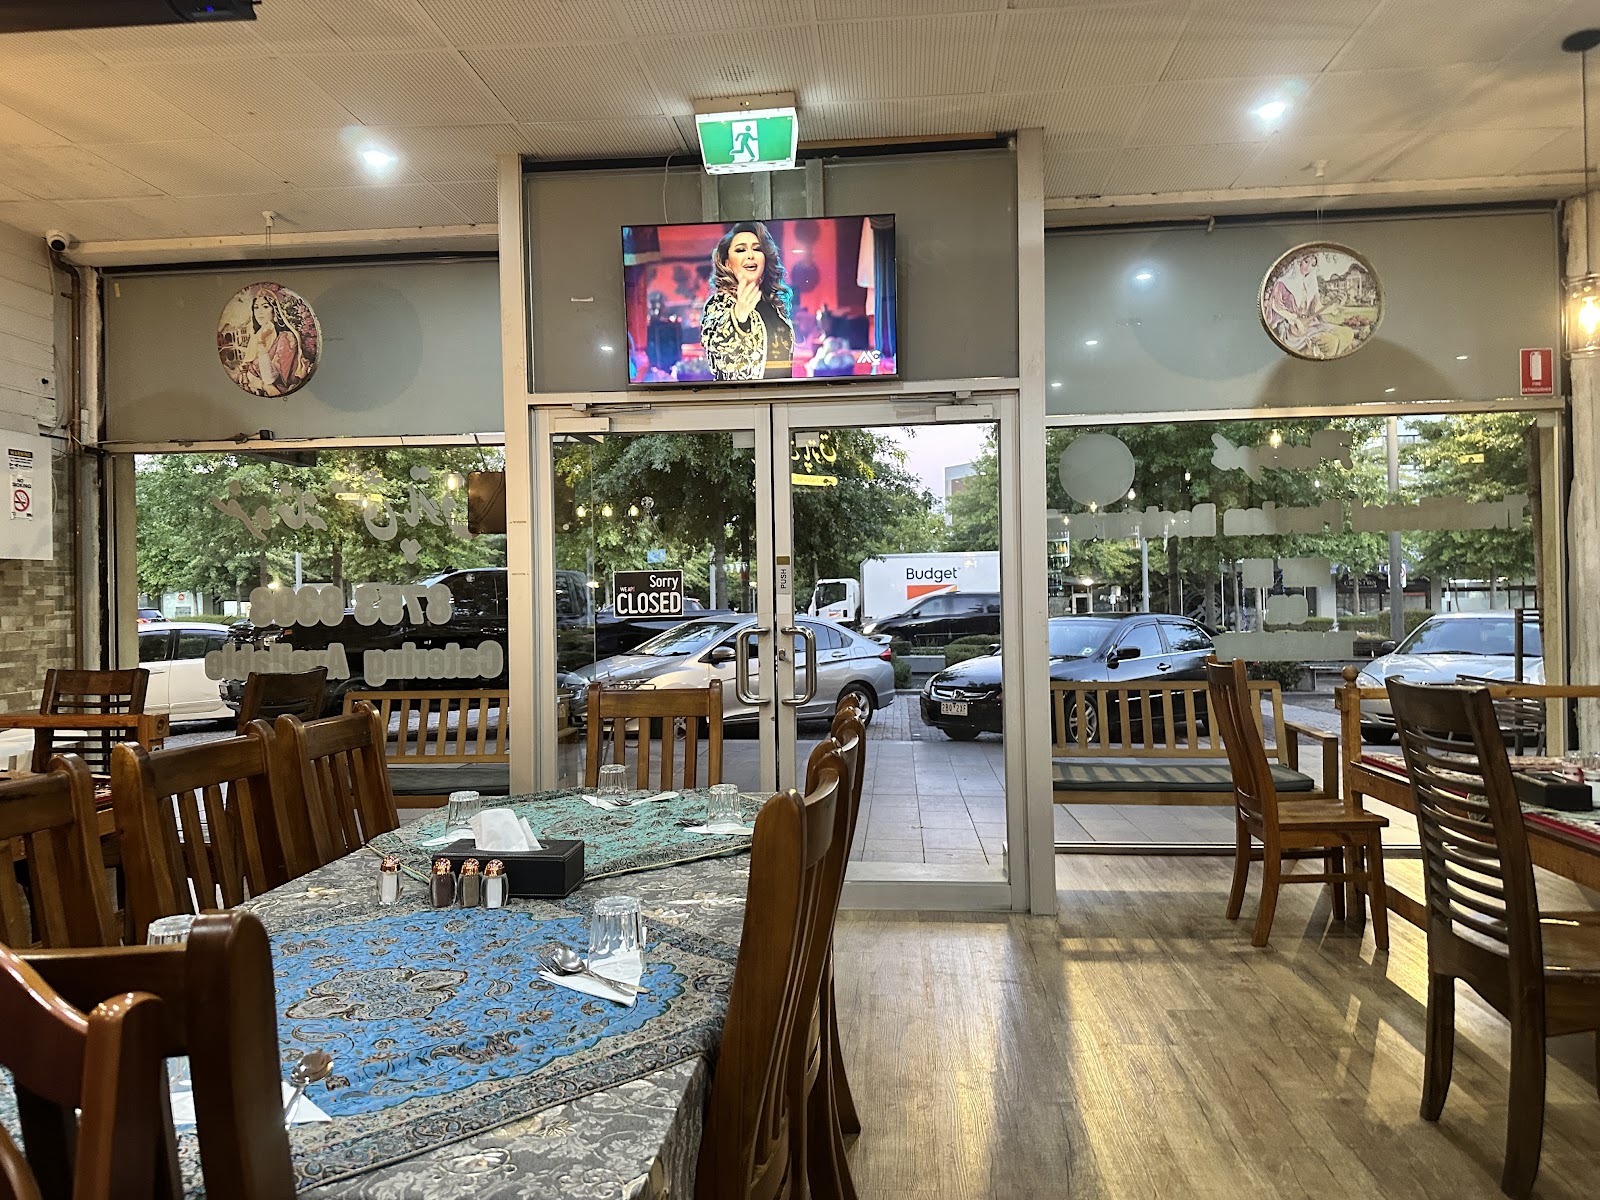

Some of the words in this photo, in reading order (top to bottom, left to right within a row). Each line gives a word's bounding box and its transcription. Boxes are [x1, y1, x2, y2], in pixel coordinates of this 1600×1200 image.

[649, 574, 679, 591] Sorry
[906, 567, 958, 582] Budget
[616, 592, 681, 614] CLOSED
